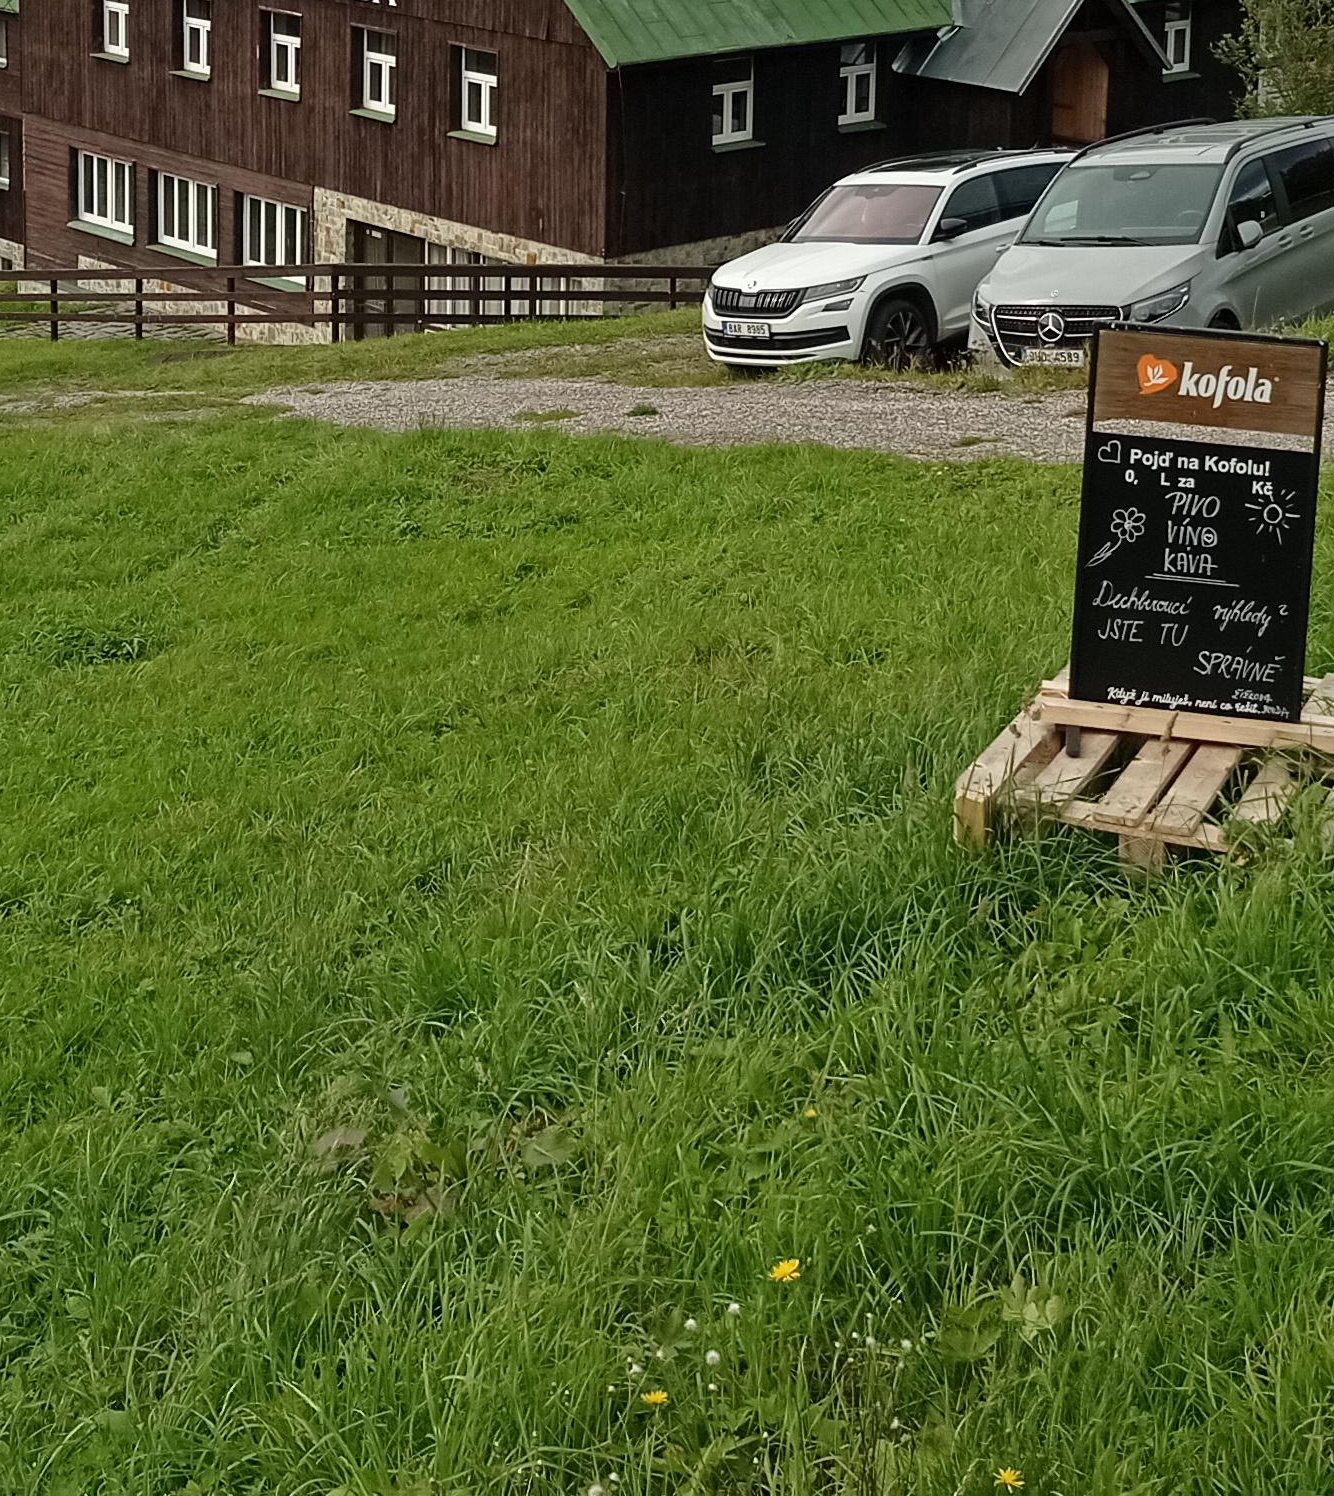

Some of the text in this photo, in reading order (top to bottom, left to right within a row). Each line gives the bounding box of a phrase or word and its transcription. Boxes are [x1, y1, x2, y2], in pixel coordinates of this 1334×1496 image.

[1177, 361, 1273, 409] kofola
[1129, 448, 1270, 477] Pojď na Kofolu!
[1160, 472, 1171, 486] L
[1177, 476, 1195, 489] za
[1251, 480, 1274, 496] Kč
[1165, 491, 1221, 518] PIVO
[1167, 518, 1218, 548] VÍNO
[1163, 546, 1219, 576] KÁVA
[1097, 618, 1189, 647] JSTE TU
[1193, 646, 1286, 683] SPRÁVNĚ
[1107, 686, 1137, 705] Když
[1194, 699, 1218, 709] není
[1220, 702, 1233, 711] co
